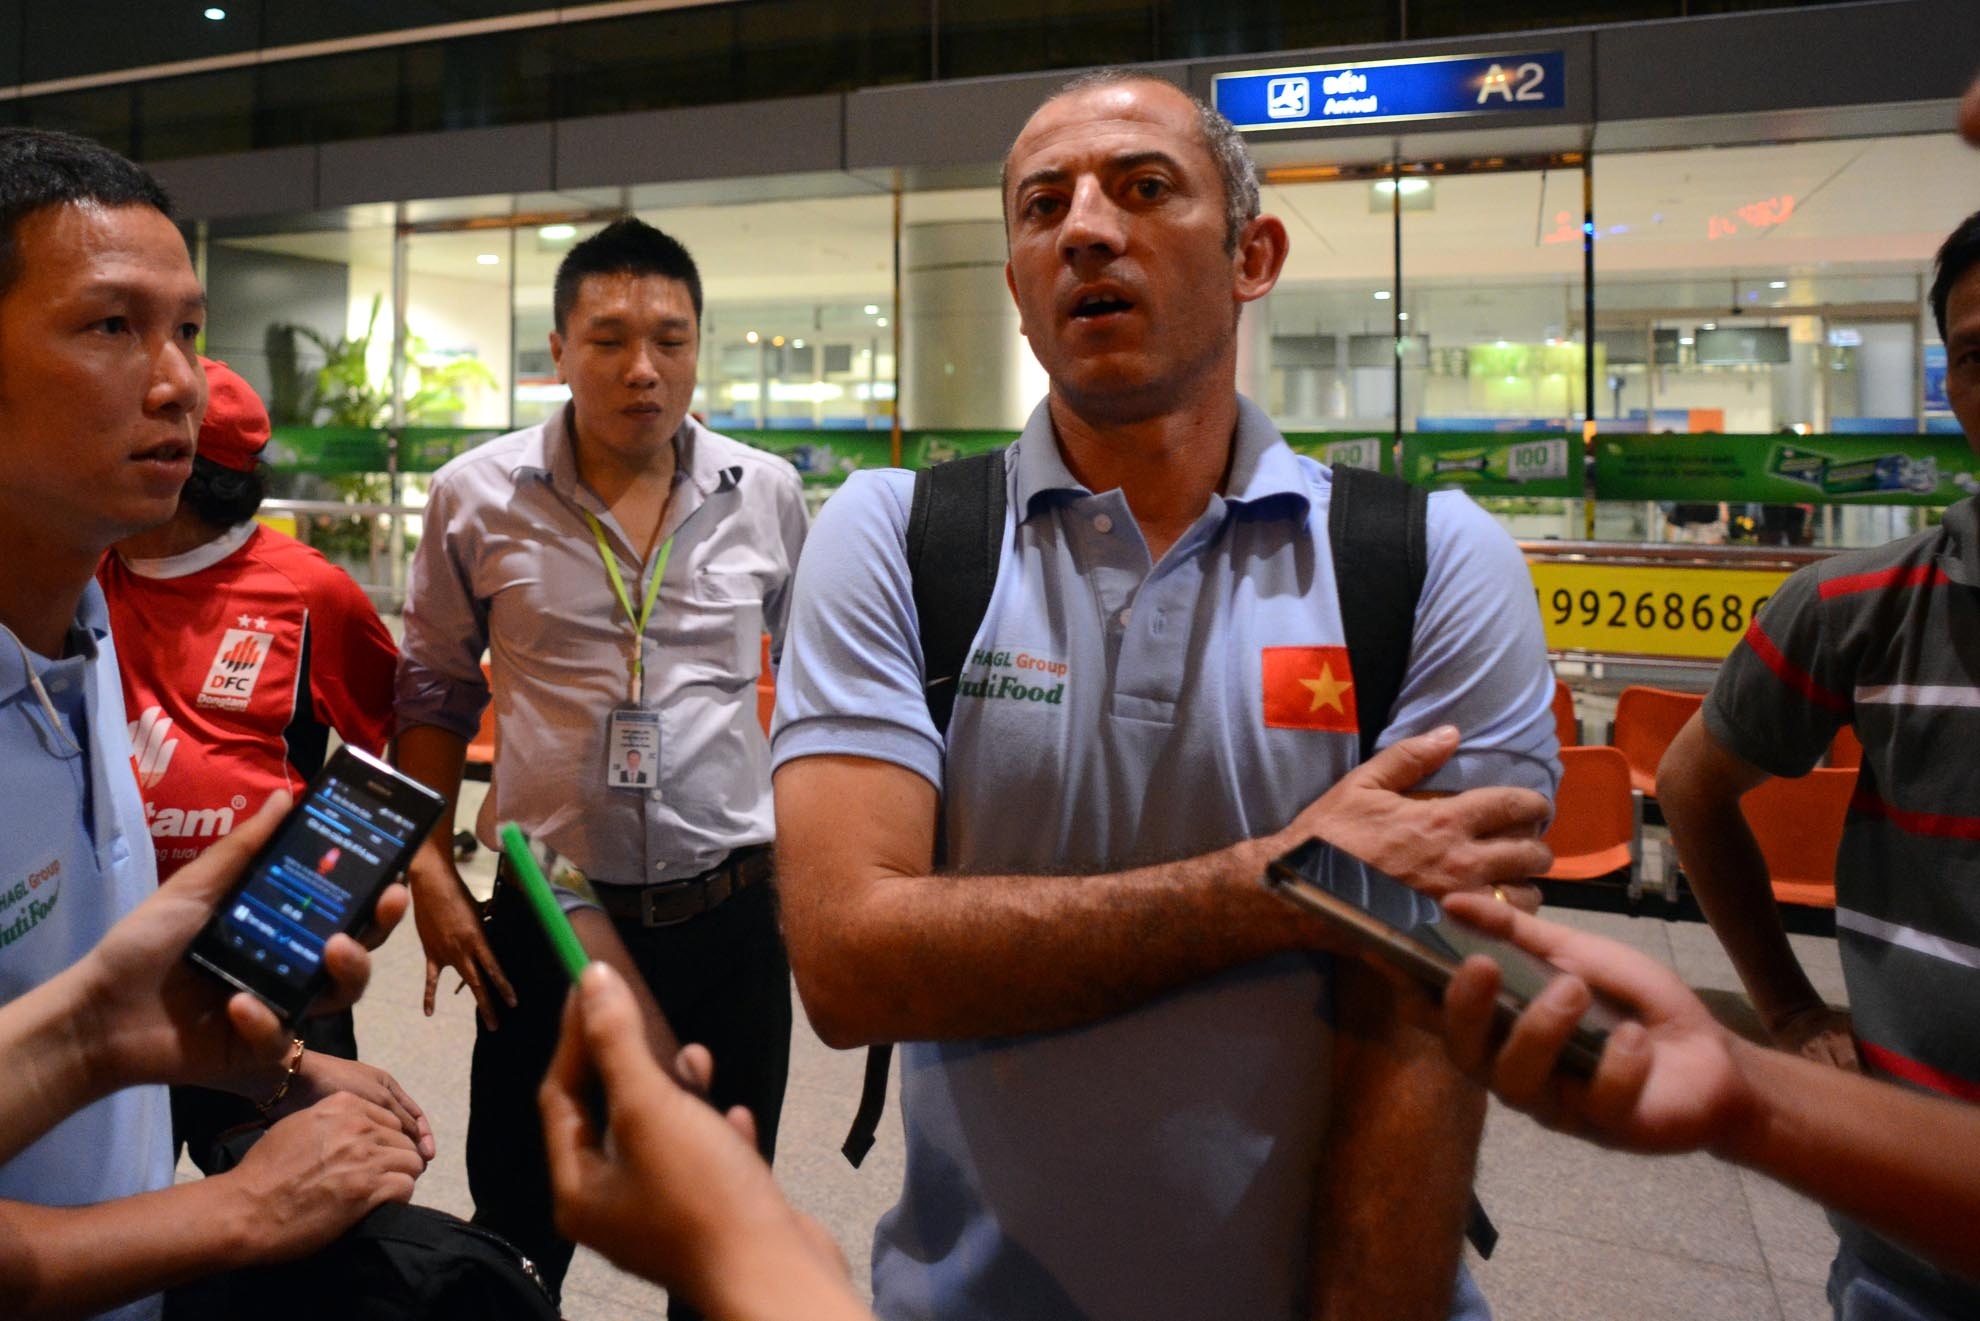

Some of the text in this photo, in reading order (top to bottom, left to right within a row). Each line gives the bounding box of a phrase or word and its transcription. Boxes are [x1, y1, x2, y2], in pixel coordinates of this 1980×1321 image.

[1477, 63, 1545, 104] A2
[1535, 588, 1770, 633] 9926868
[972, 649, 1068, 678] HAGL Group
[210, 675, 250, 691] DFC
[28, 860, 60, 890] Group
